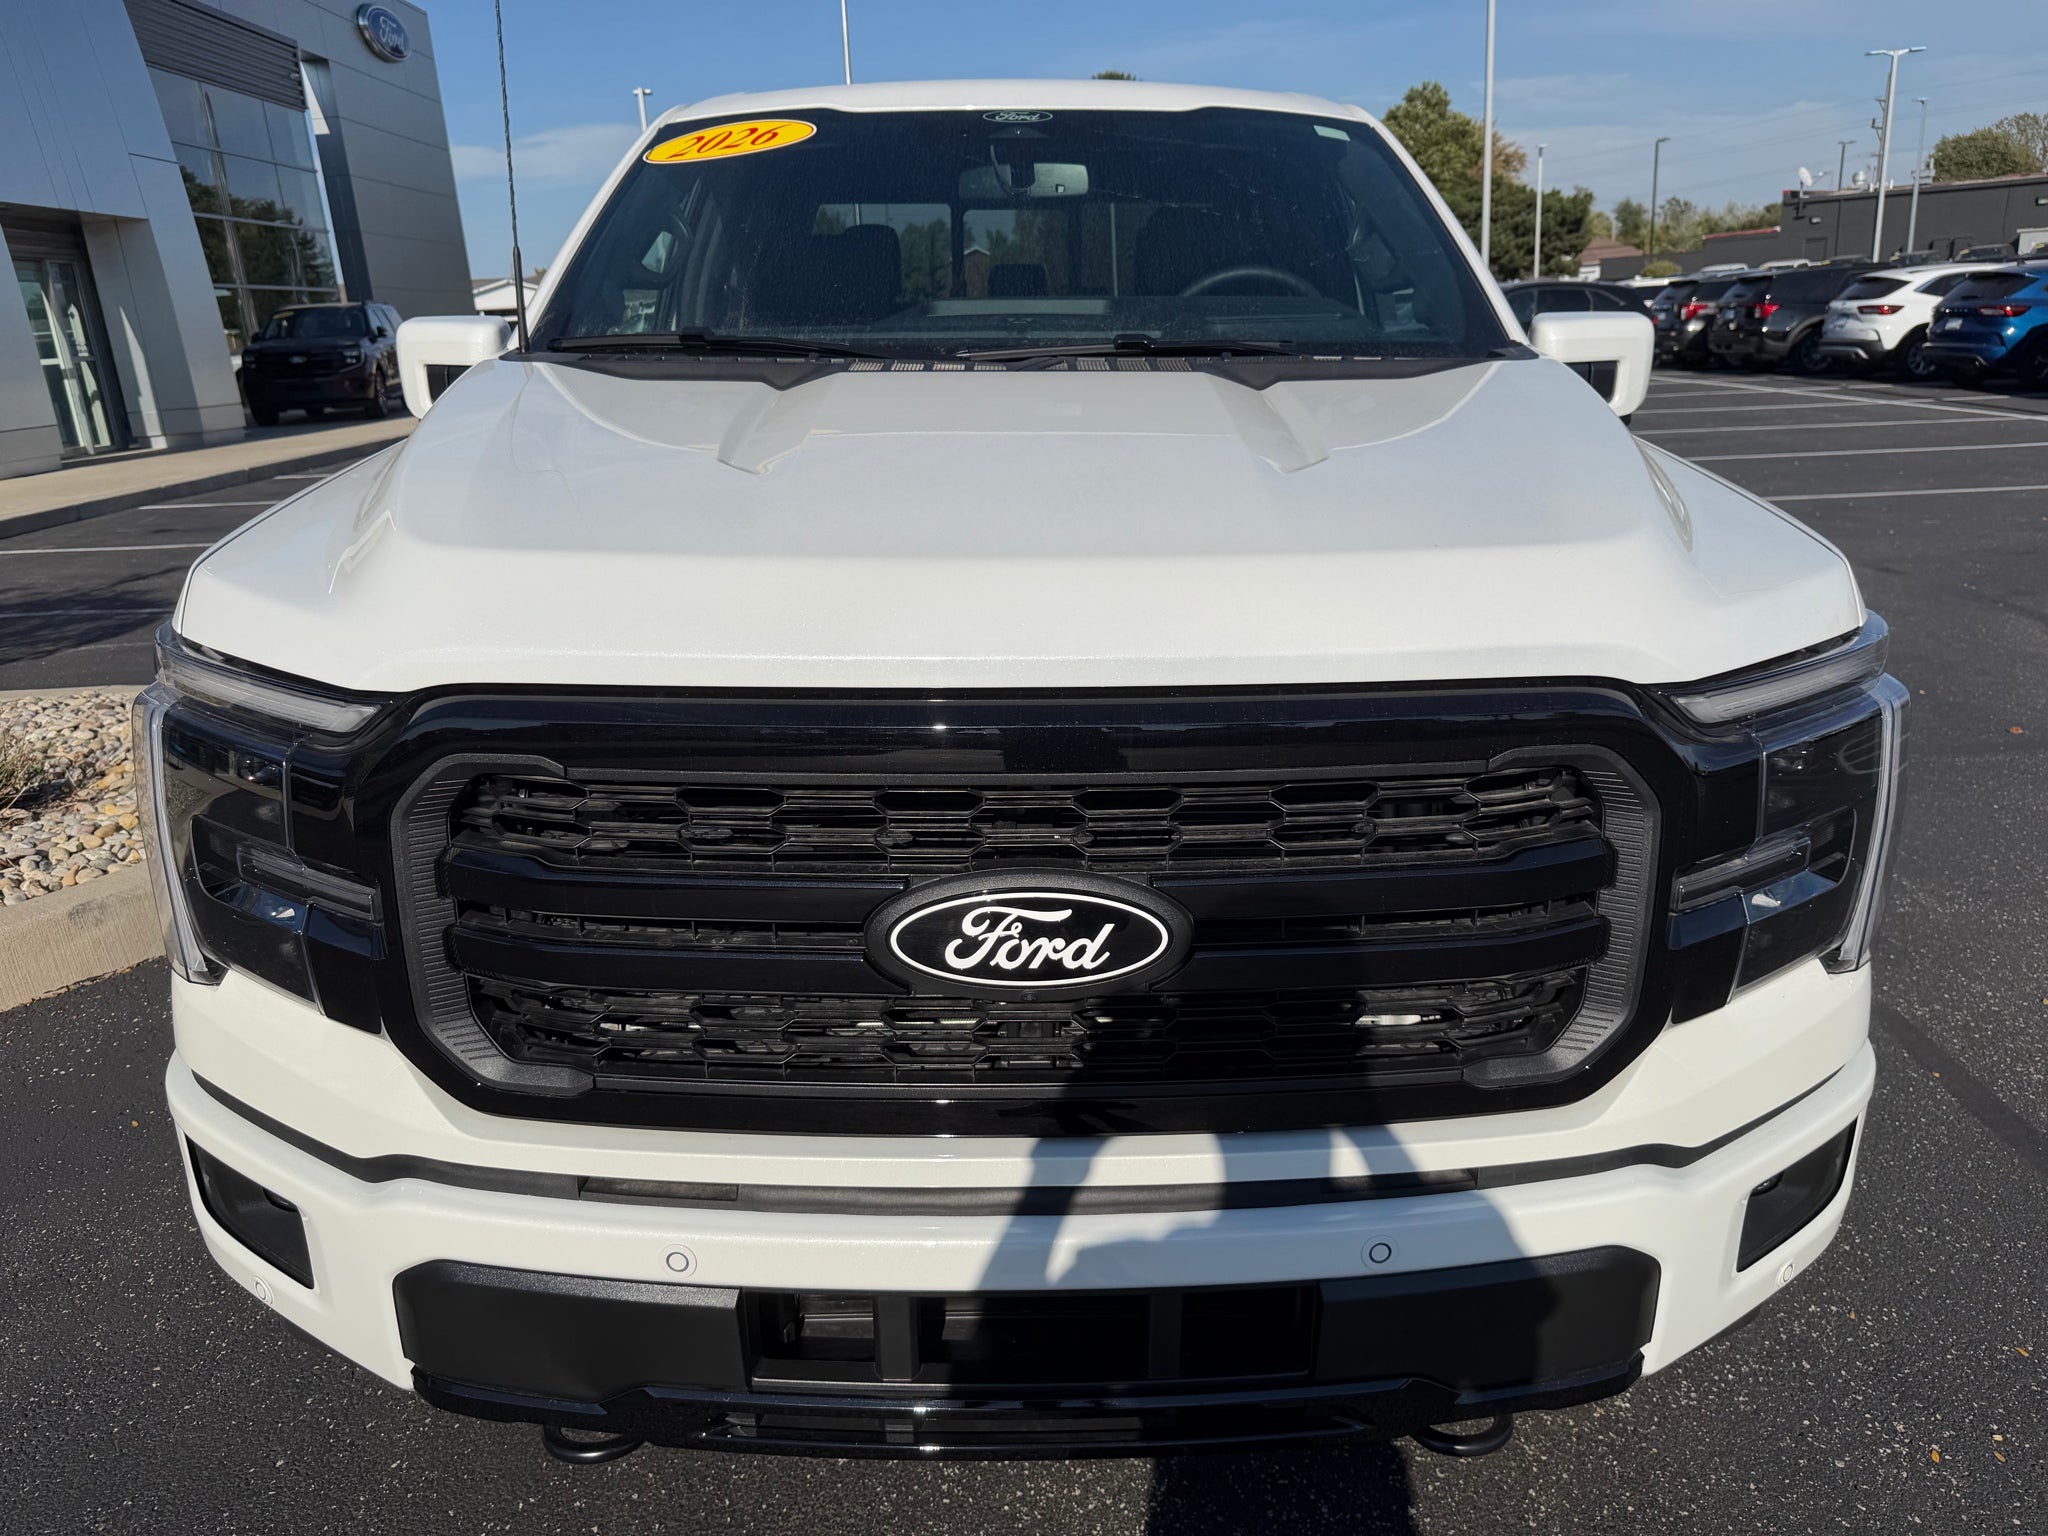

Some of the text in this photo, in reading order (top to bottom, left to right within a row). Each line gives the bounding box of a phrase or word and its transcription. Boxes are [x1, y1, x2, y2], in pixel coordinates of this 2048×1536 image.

[379, 15, 405, 50] Ford
[995, 111, 1041, 121] Ford
[665, 123, 793, 159] 2026
[944, 906, 1115, 970] Ford
